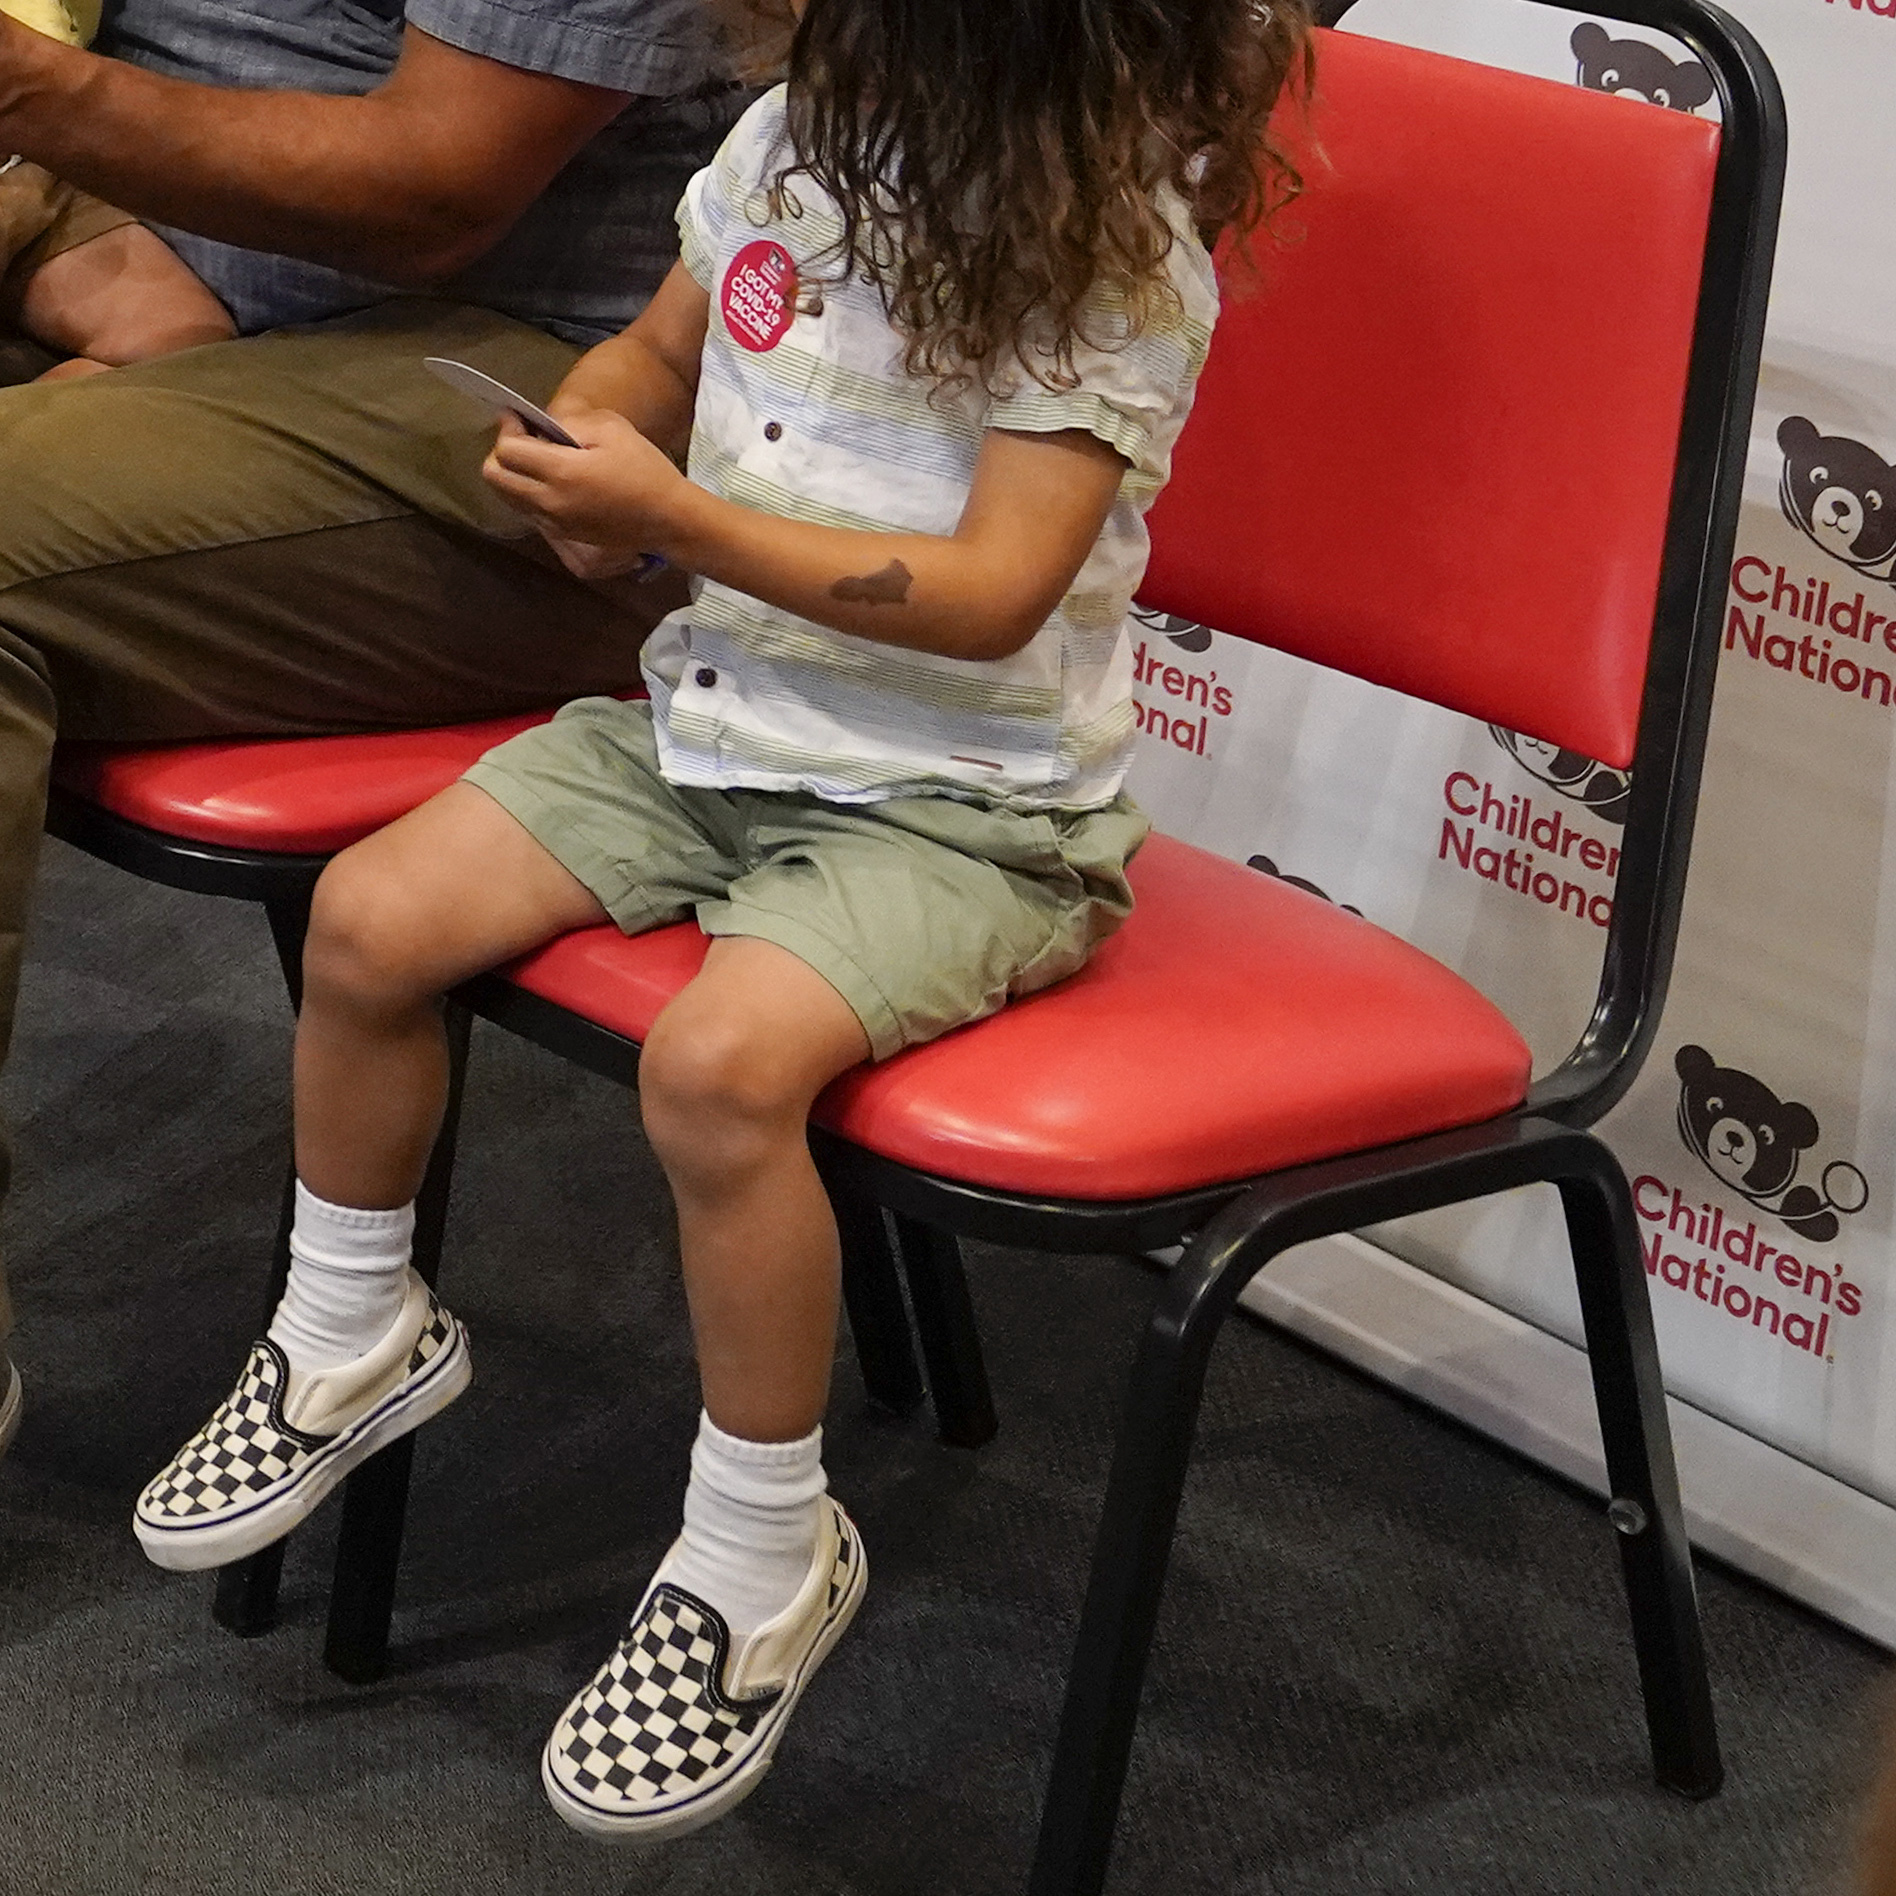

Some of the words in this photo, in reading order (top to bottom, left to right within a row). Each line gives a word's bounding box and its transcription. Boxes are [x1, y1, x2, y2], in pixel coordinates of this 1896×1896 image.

[729, 291, 773, 341] VACCINE
[731, 276, 781, 327] COVID-19
[739, 264, 749, 276] I
[745, 269, 770, 296] GOT
[765, 288, 785, 310] MY
[1730, 555, 1896, 650] Childre
[1132, 644, 1233, 716] dren's
[1726, 606, 1896, 708] Nation
[1444, 770, 1622, 876] Childre
[1438, 818, 1615, 929] Nationa
[1631, 1173, 1864, 1316] Children's
